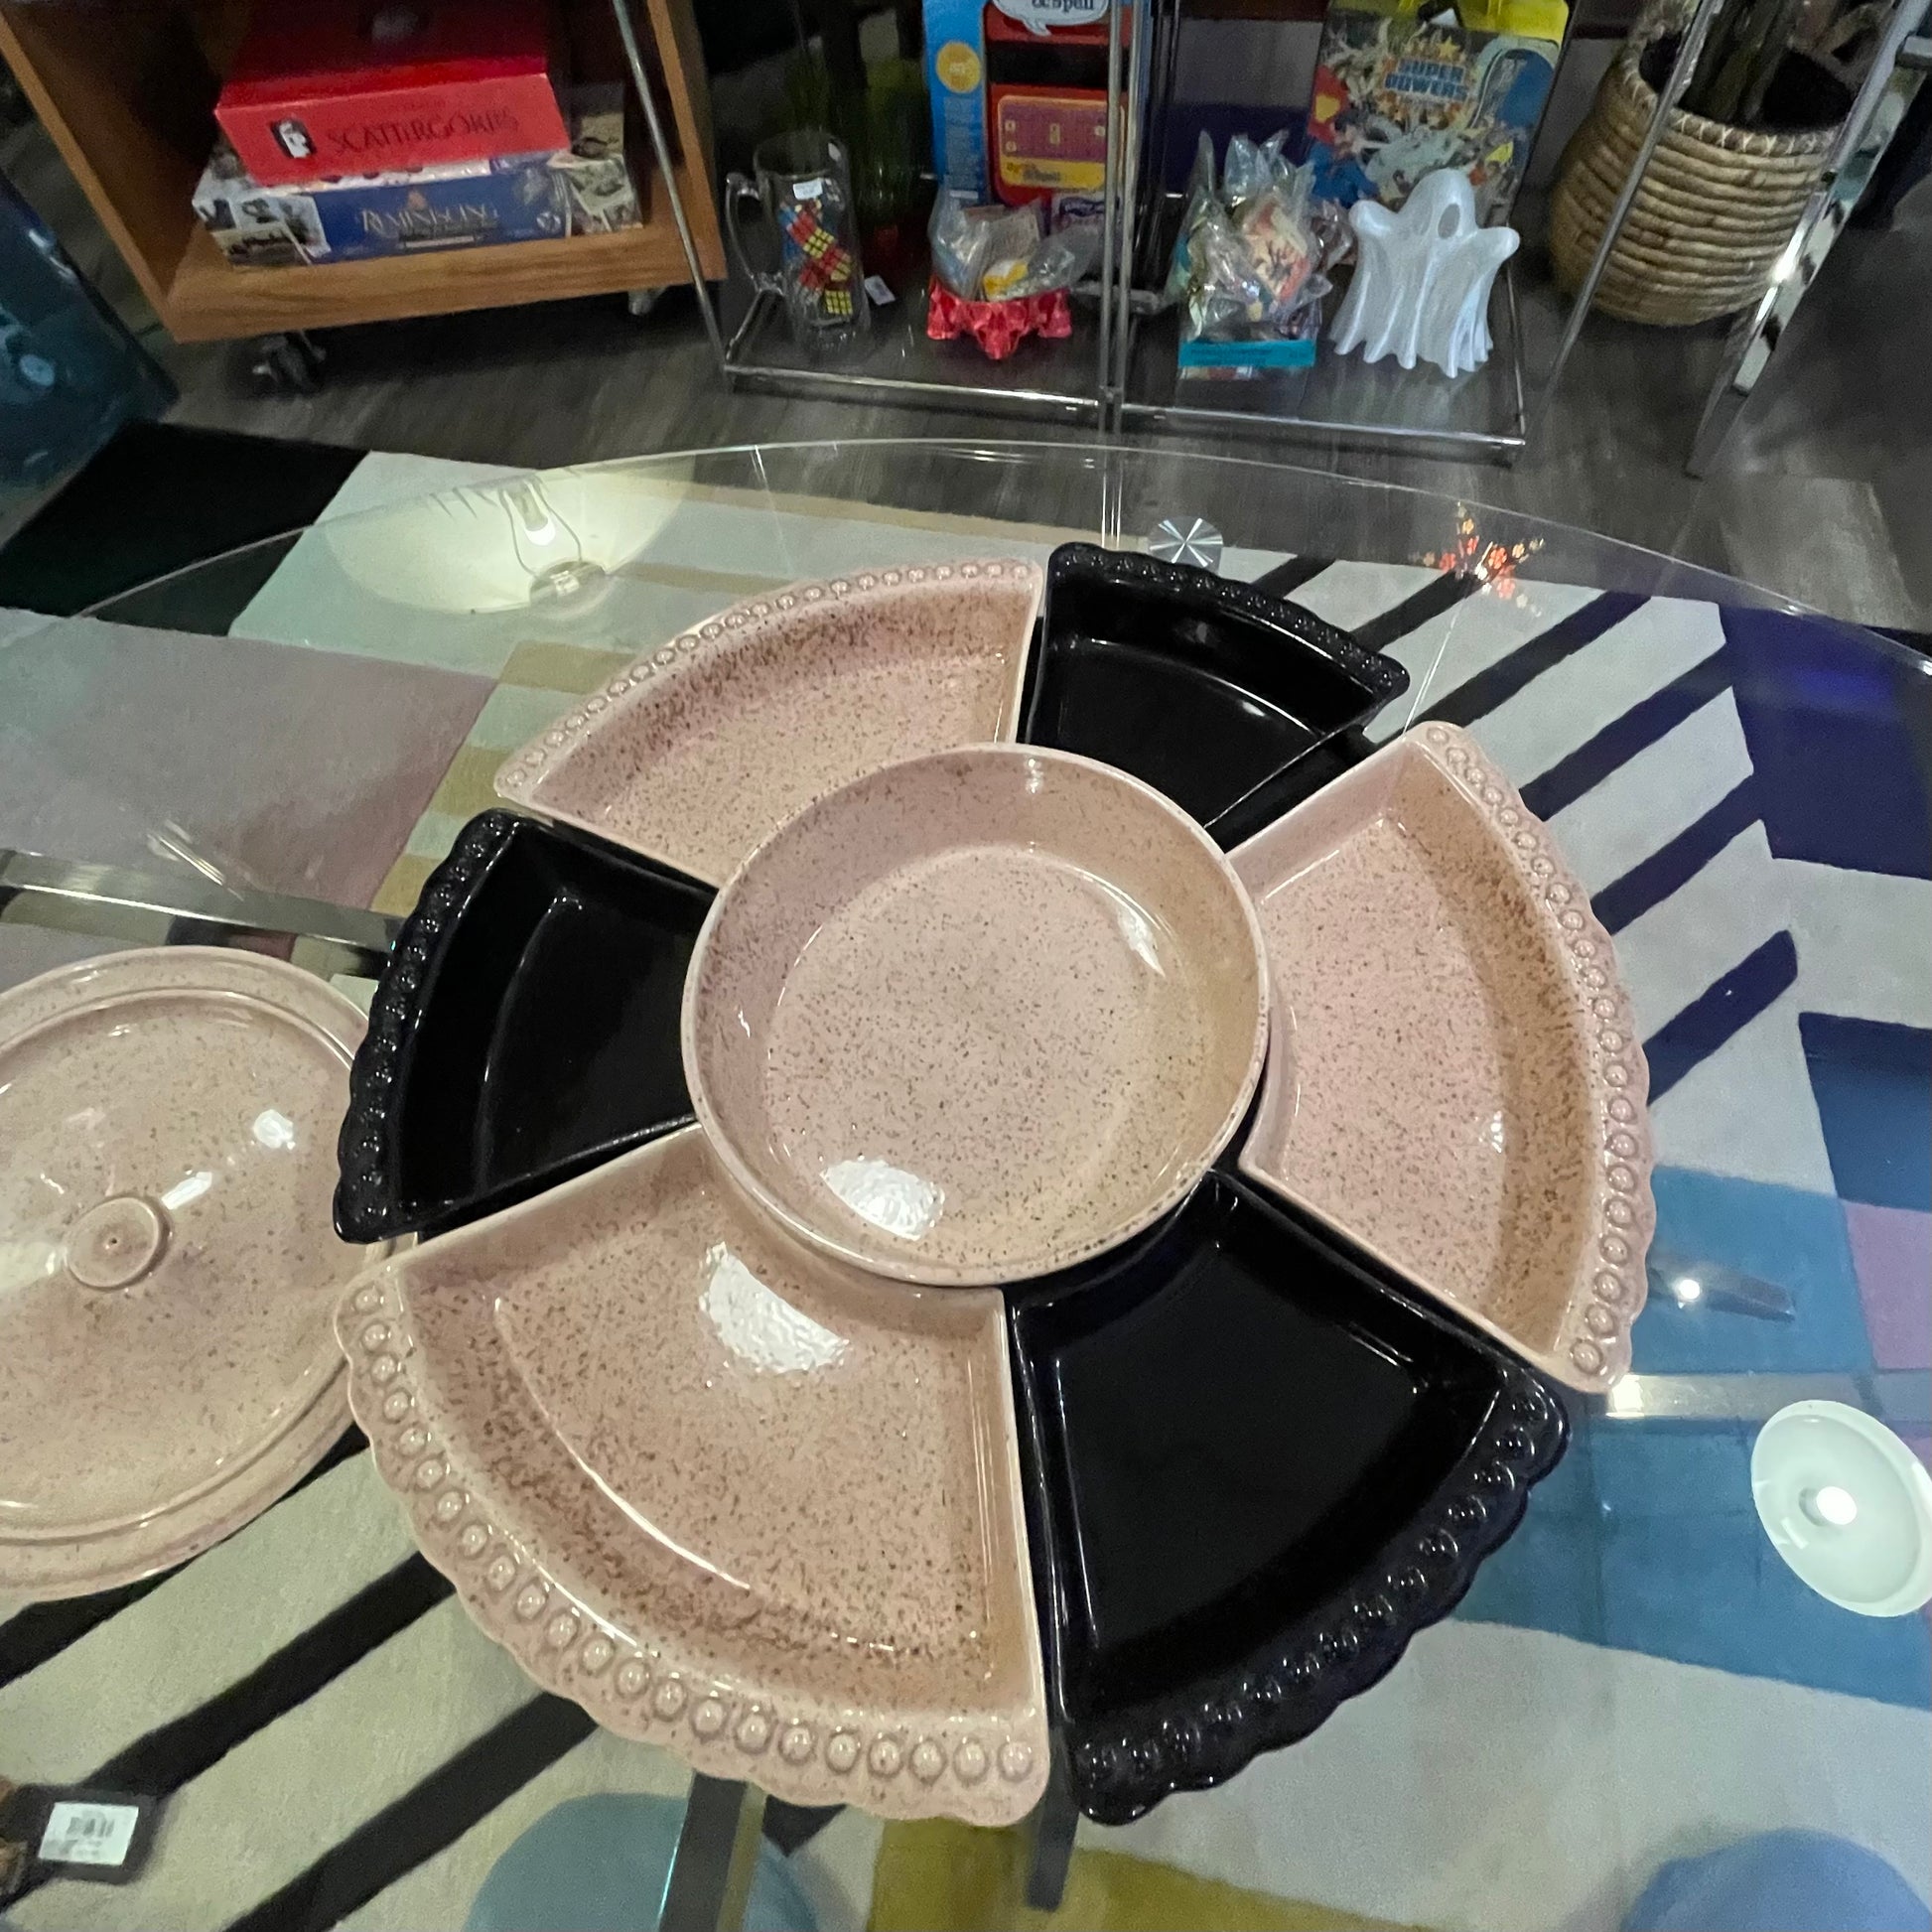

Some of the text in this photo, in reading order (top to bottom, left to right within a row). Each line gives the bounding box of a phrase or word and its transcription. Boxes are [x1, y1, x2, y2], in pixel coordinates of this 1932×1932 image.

[1385, 72, 1468, 100] POWERS
[1397, 57, 1465, 86] SUPER
[327, 106, 520, 155] SCATTERGORIES
